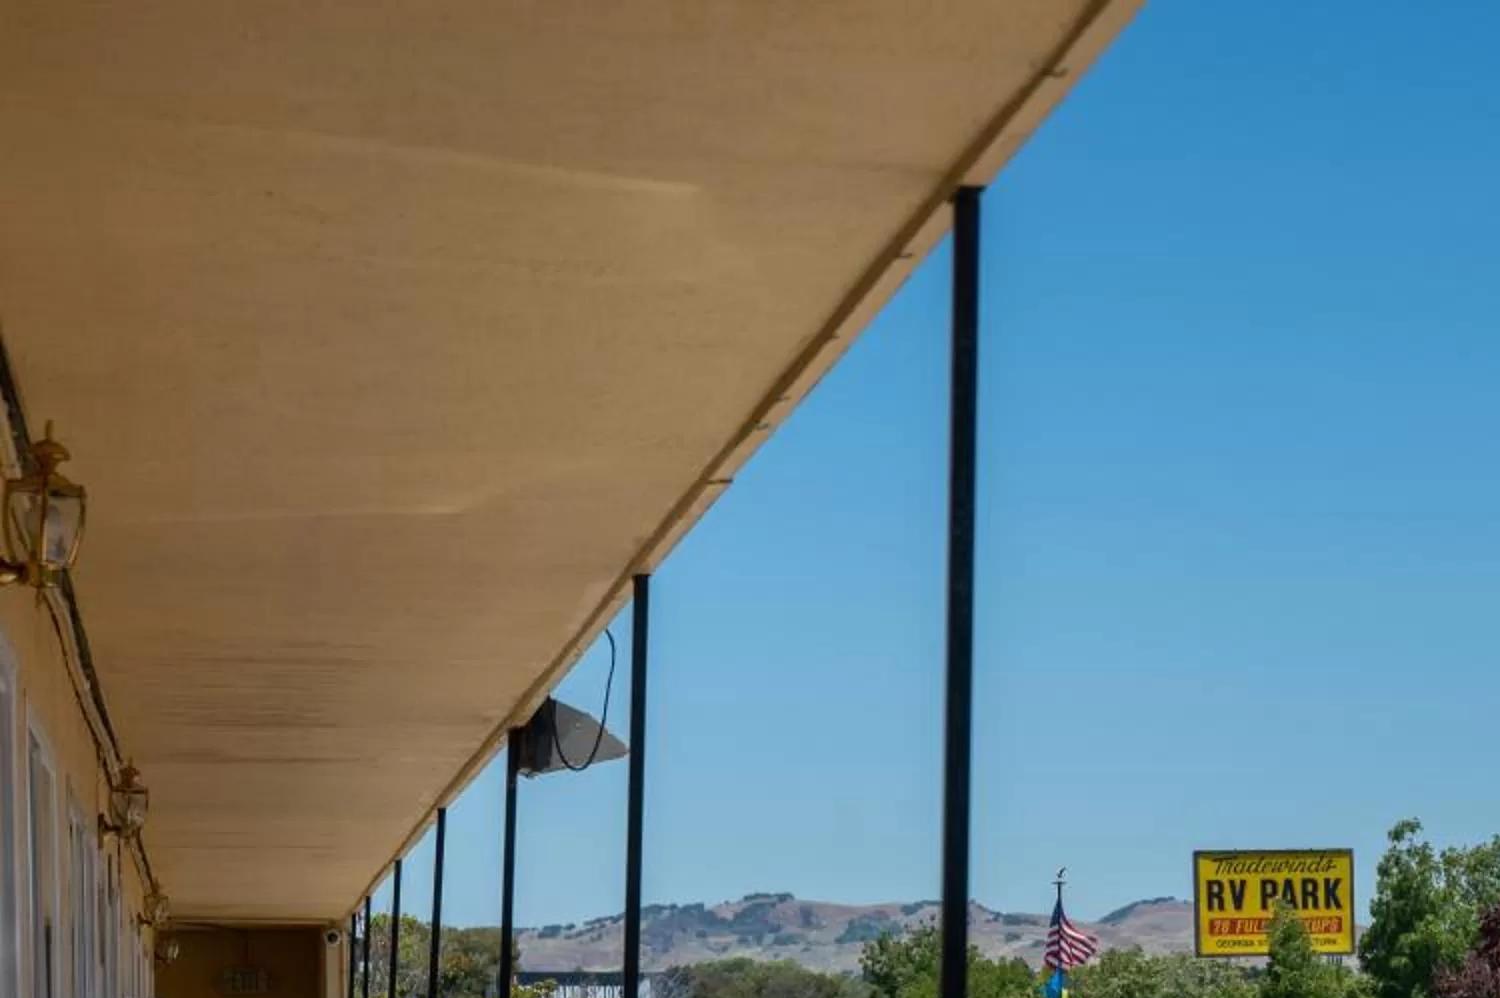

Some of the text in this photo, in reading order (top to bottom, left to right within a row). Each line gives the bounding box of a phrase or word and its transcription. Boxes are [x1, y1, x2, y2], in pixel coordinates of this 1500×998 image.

[1211, 855, 1336, 876] Tradewinds
[1207, 877, 1342, 911] RV PARK
